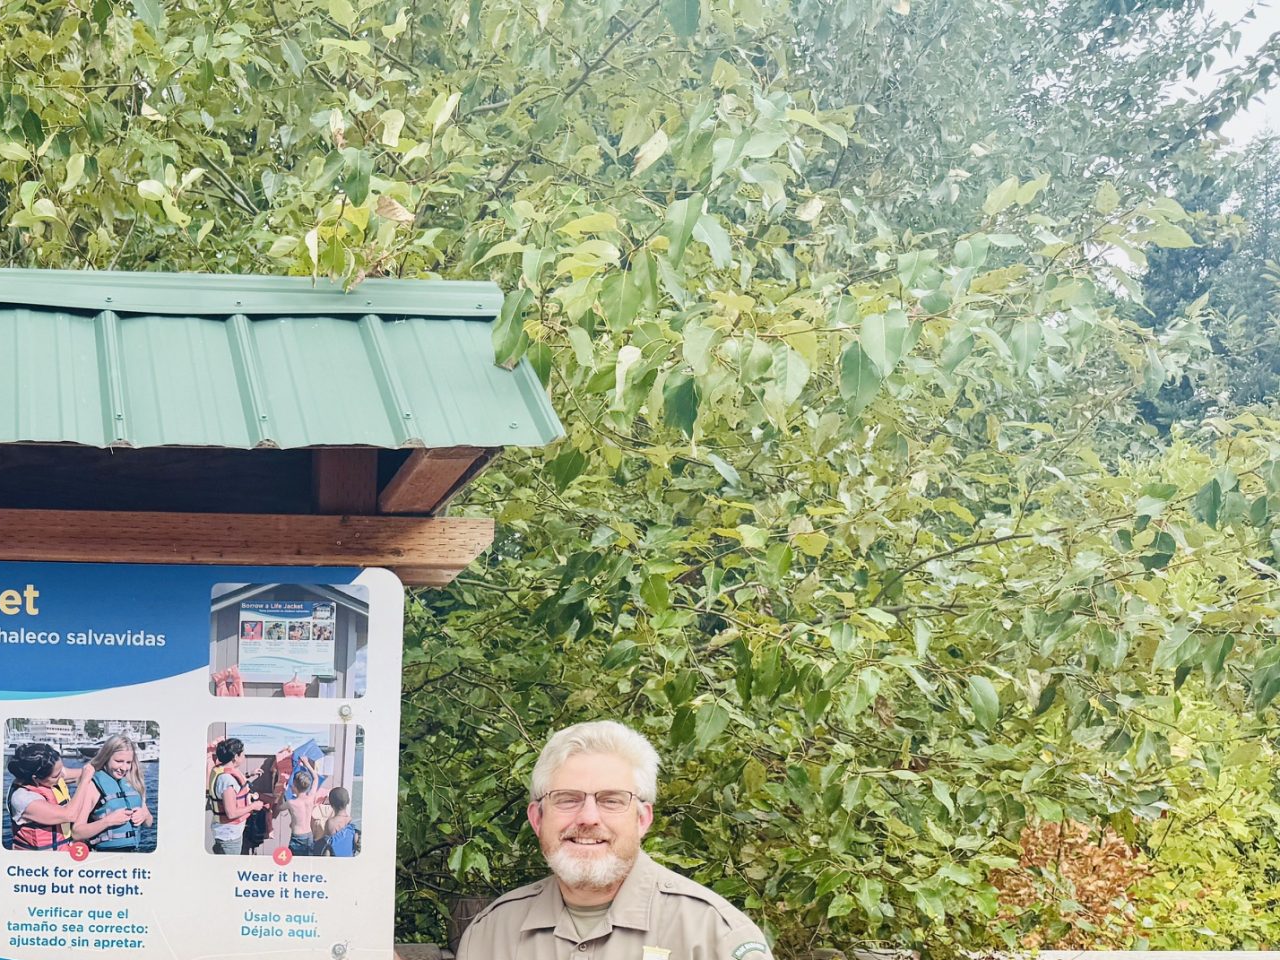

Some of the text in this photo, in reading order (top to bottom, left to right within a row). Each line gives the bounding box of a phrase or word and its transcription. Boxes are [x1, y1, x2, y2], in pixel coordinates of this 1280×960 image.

[67, 627, 166, 646] salvavidas
[76, 845, 83, 857] 3
[278, 850, 287, 861] 4
[7, 866, 150, 879] Check for correct fit:
[237, 871, 327, 883] Wear it here.
[13, 882, 143, 897] snug but not tight.
[235, 887, 328, 899] Leave it here.
[28, 907, 128, 921] Verificar que el
[244, 909, 318, 926] Úsalo aquí.
[7, 921, 148, 934] tamaño sea correcto:
[241, 925, 320, 940] Déjalo aquí.
[10, 936, 145, 949] ajustado sin apretar.
